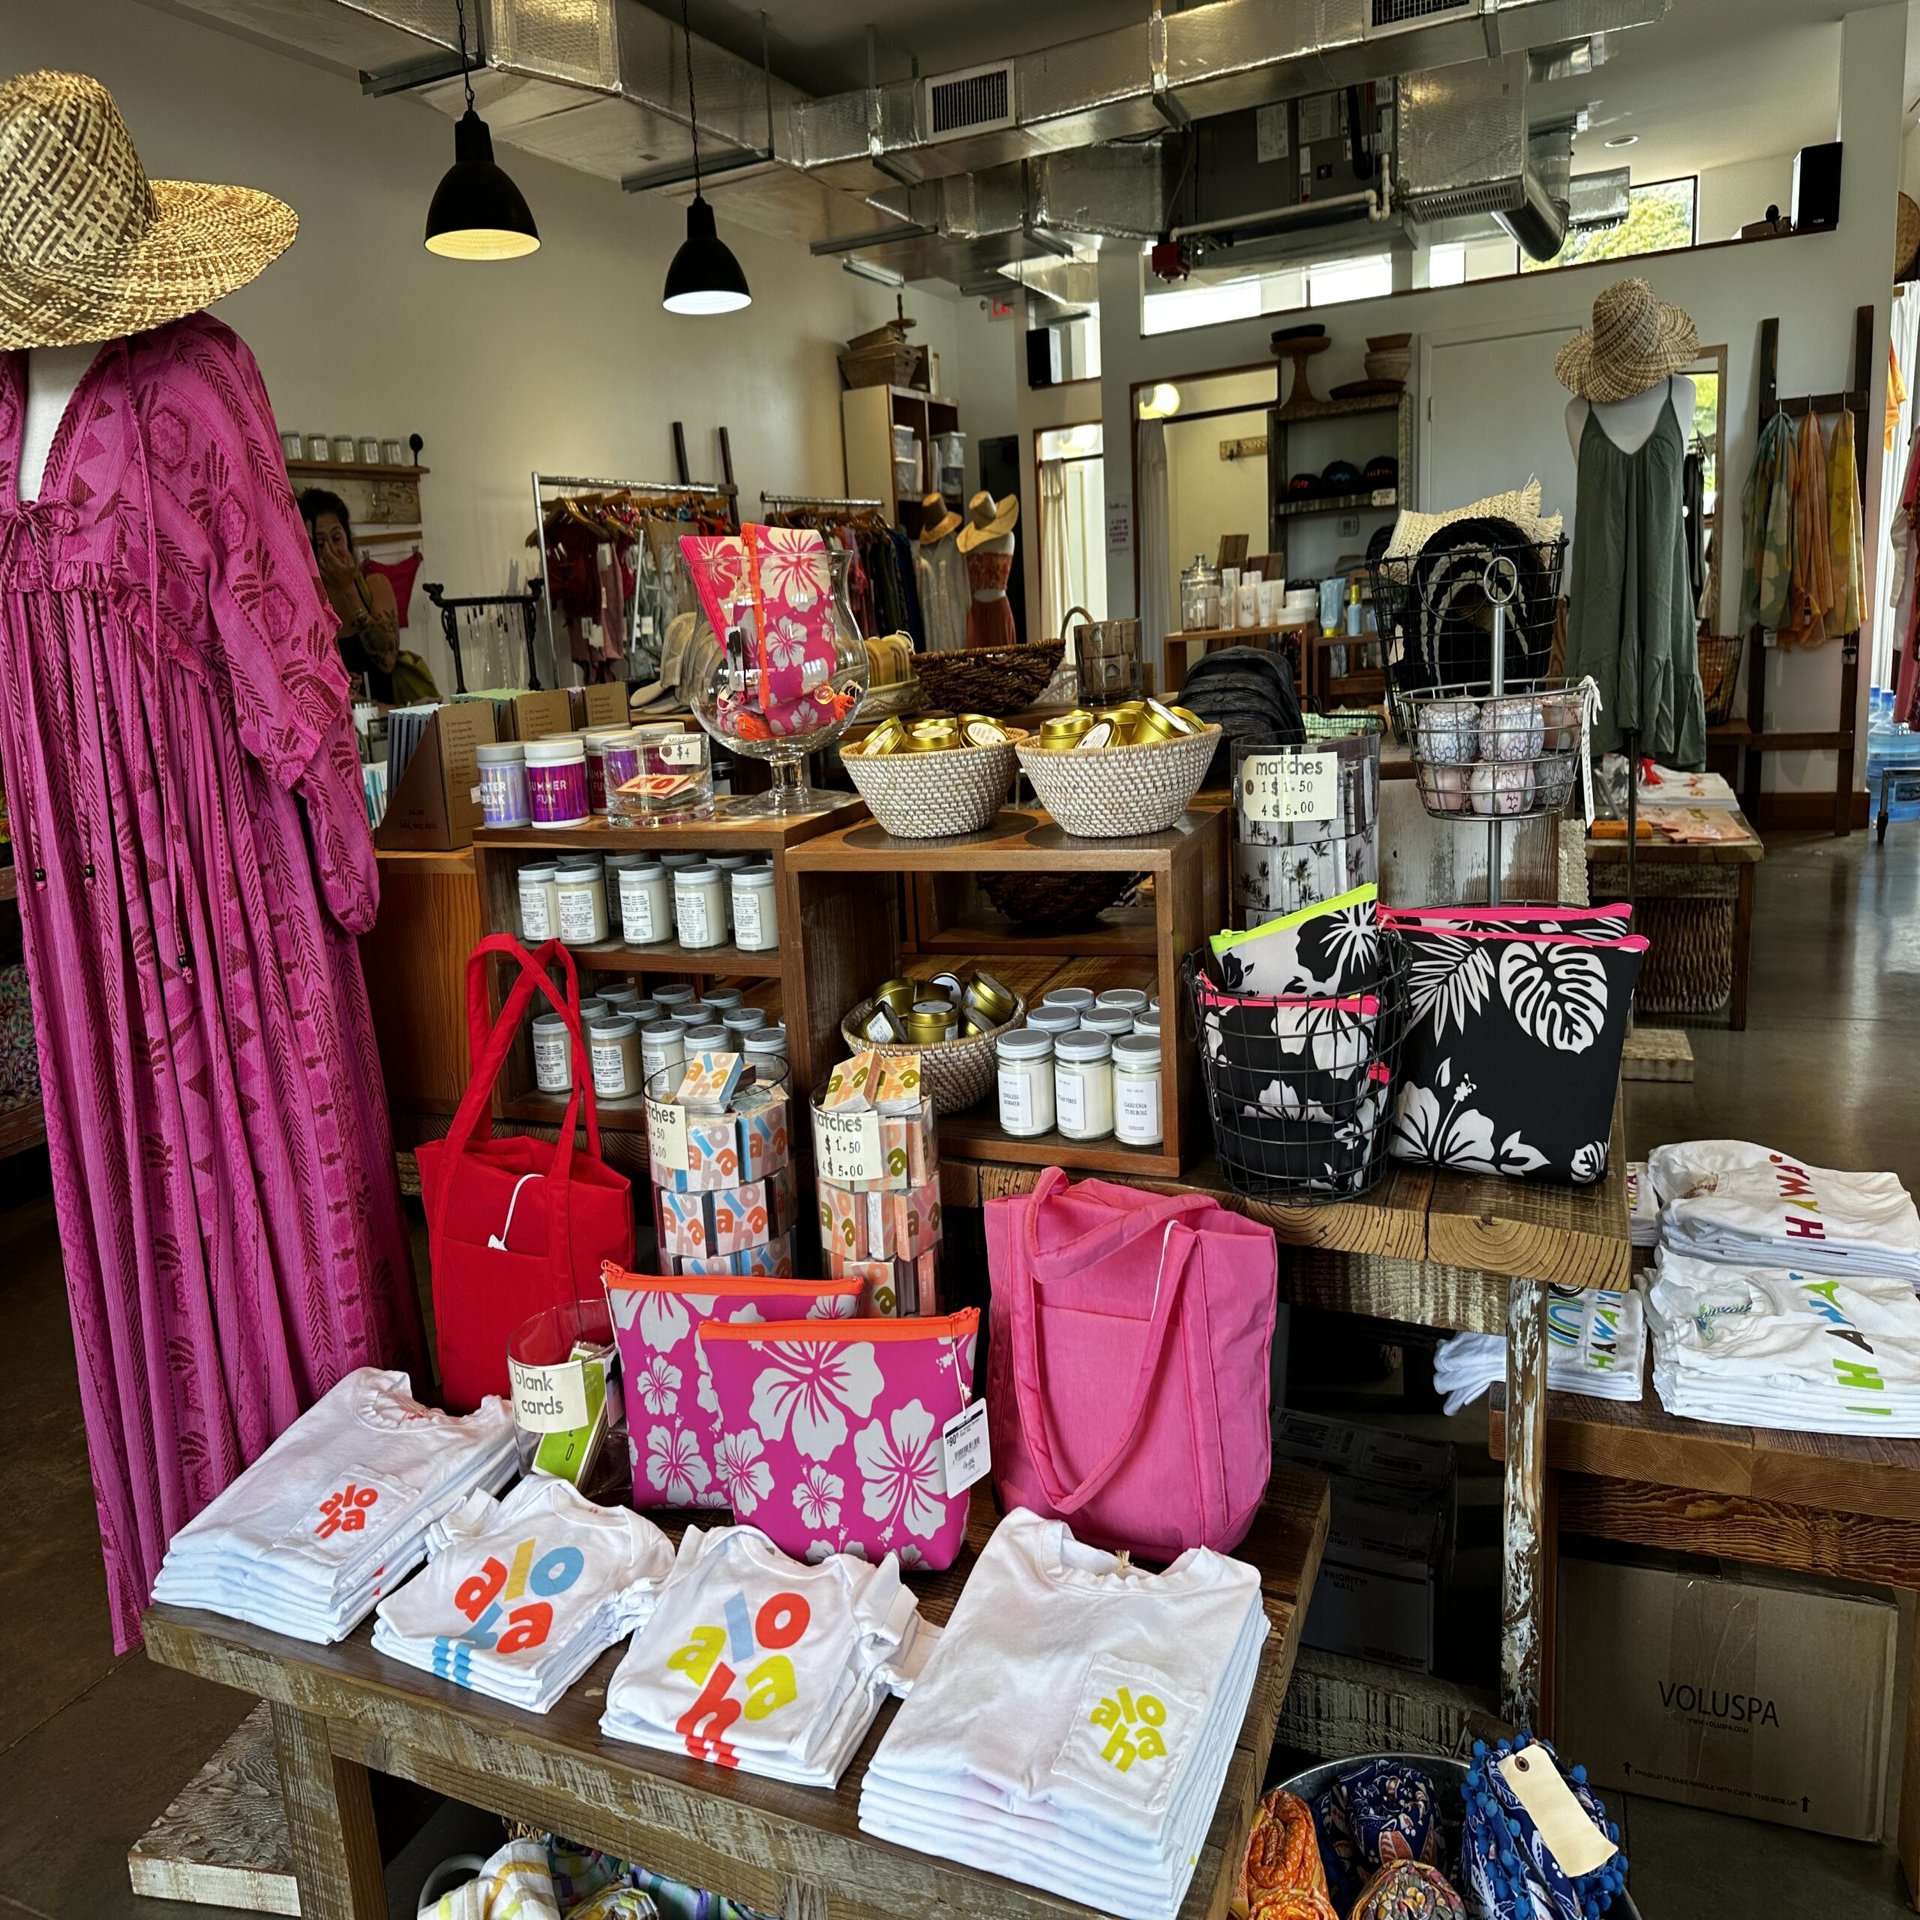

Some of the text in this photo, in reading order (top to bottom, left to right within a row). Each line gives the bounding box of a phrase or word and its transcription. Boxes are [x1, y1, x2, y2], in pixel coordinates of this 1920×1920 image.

[1255, 755, 1323, 776] matches
[536, 794, 556, 805] FUN
[647, 1101, 676, 1125] tches
[814, 1111, 862, 1133] atches
[514, 1364, 554, 1392] blank
[521, 1396, 564, 1416] cards
[1657, 1680, 1780, 1729] VOLUSPA
[1664, 1774, 1689, 1787] PLEASE
[1689, 1779, 1715, 1792] HANDLE
[1715, 1785, 1734, 1795] WITH
